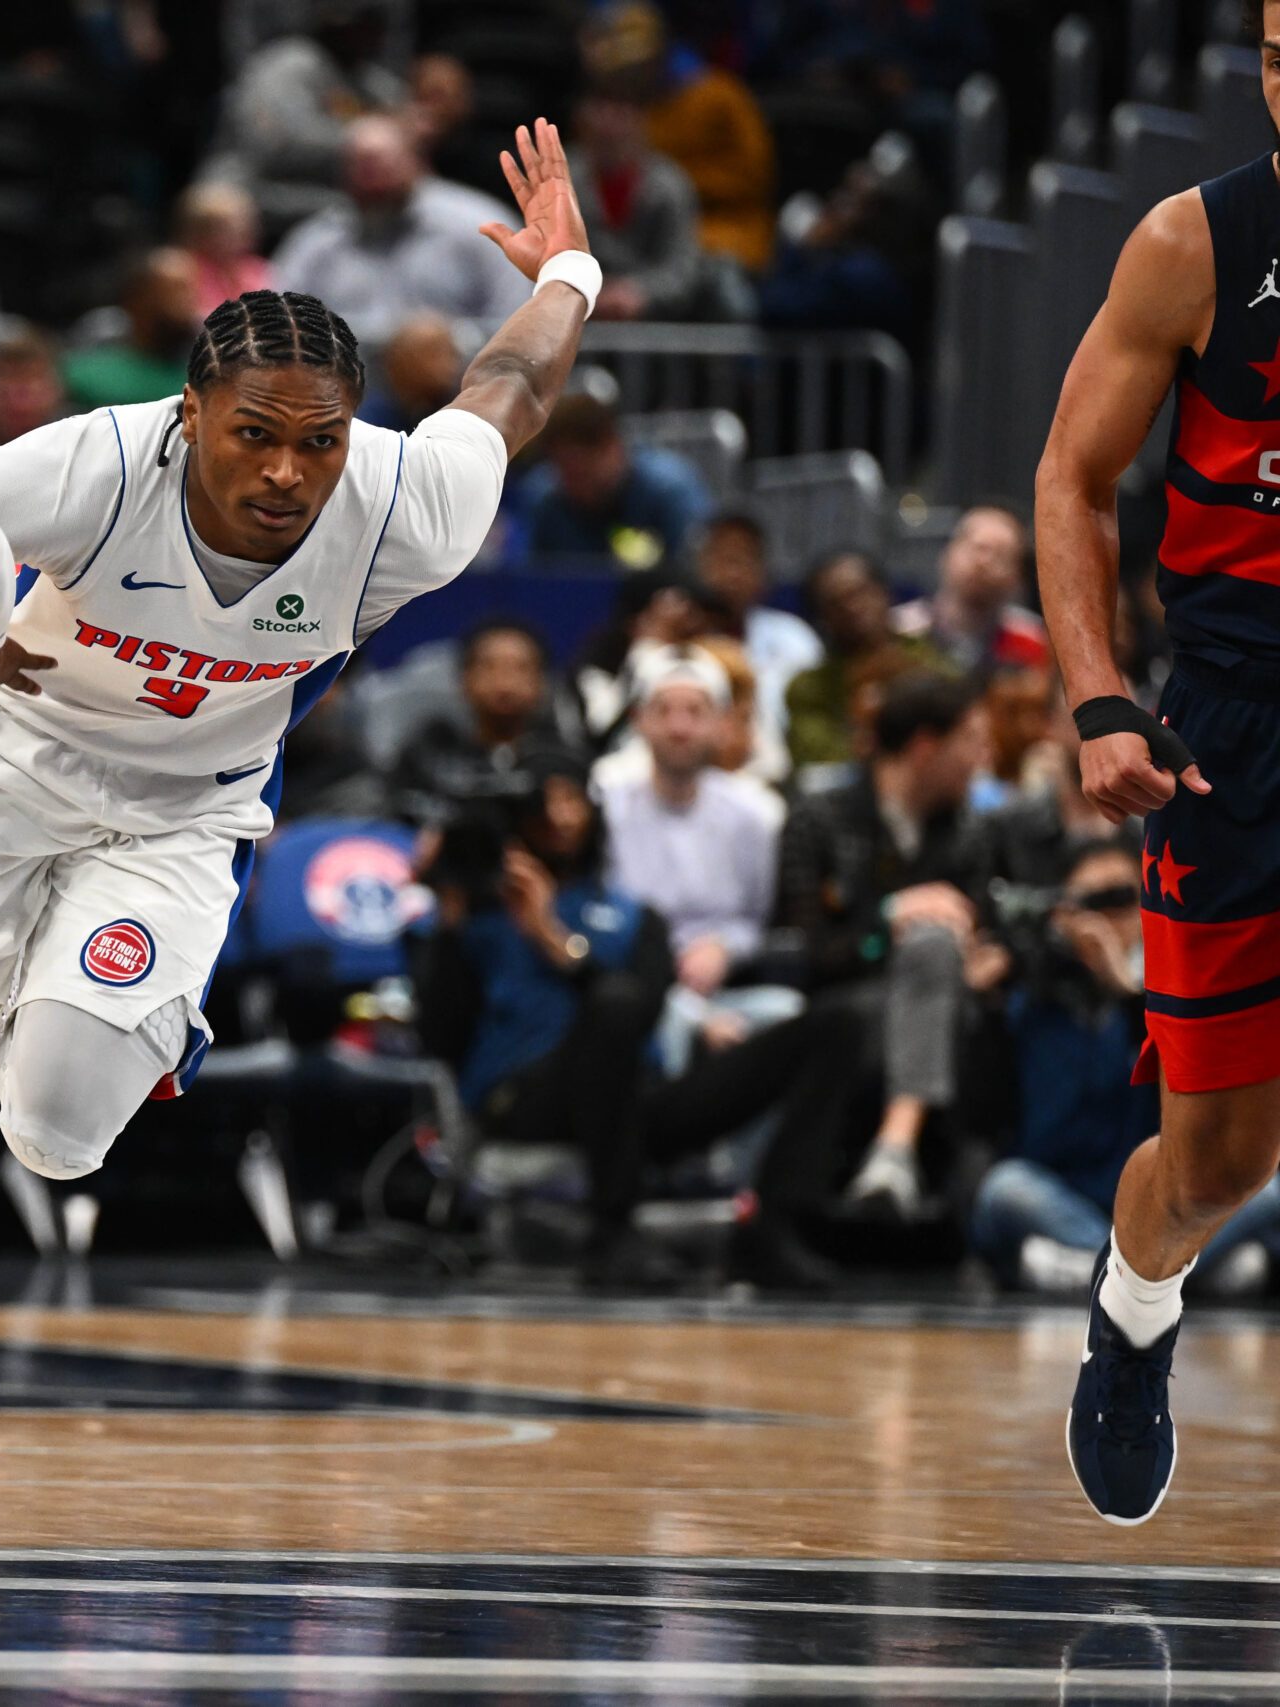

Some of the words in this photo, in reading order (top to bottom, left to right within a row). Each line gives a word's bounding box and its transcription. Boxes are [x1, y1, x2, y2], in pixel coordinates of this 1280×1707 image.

[252, 618, 321, 633] StockX
[75, 619, 317, 682] PISTONS
[93, 945, 137, 972] PISTONS
[99, 935, 143, 961] DETROIT
